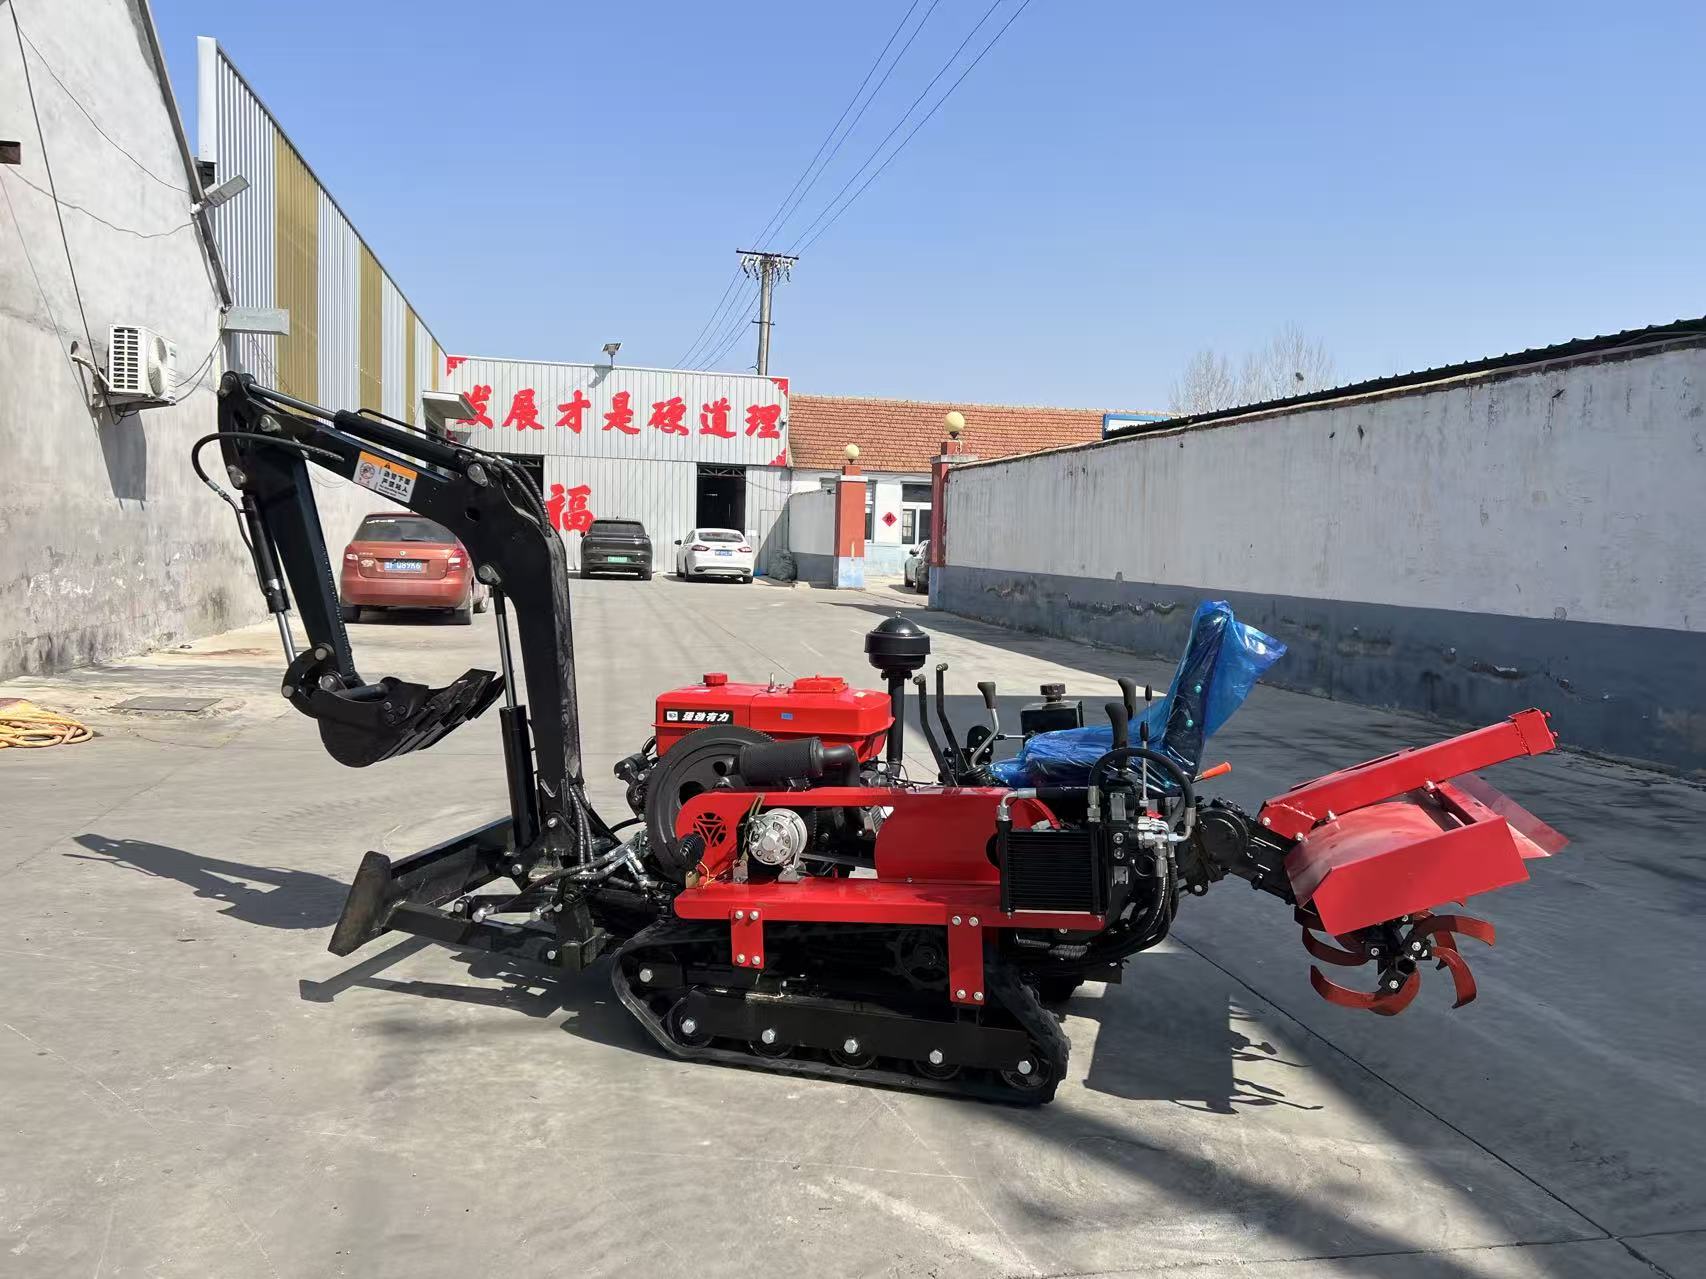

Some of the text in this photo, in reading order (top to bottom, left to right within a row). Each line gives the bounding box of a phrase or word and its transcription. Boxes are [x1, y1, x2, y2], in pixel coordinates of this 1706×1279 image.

[456, 384, 782, 438] 发展才是硬道理
[545, 483, 594, 533] 福
[682, 711, 729, 722] 强劲有力
